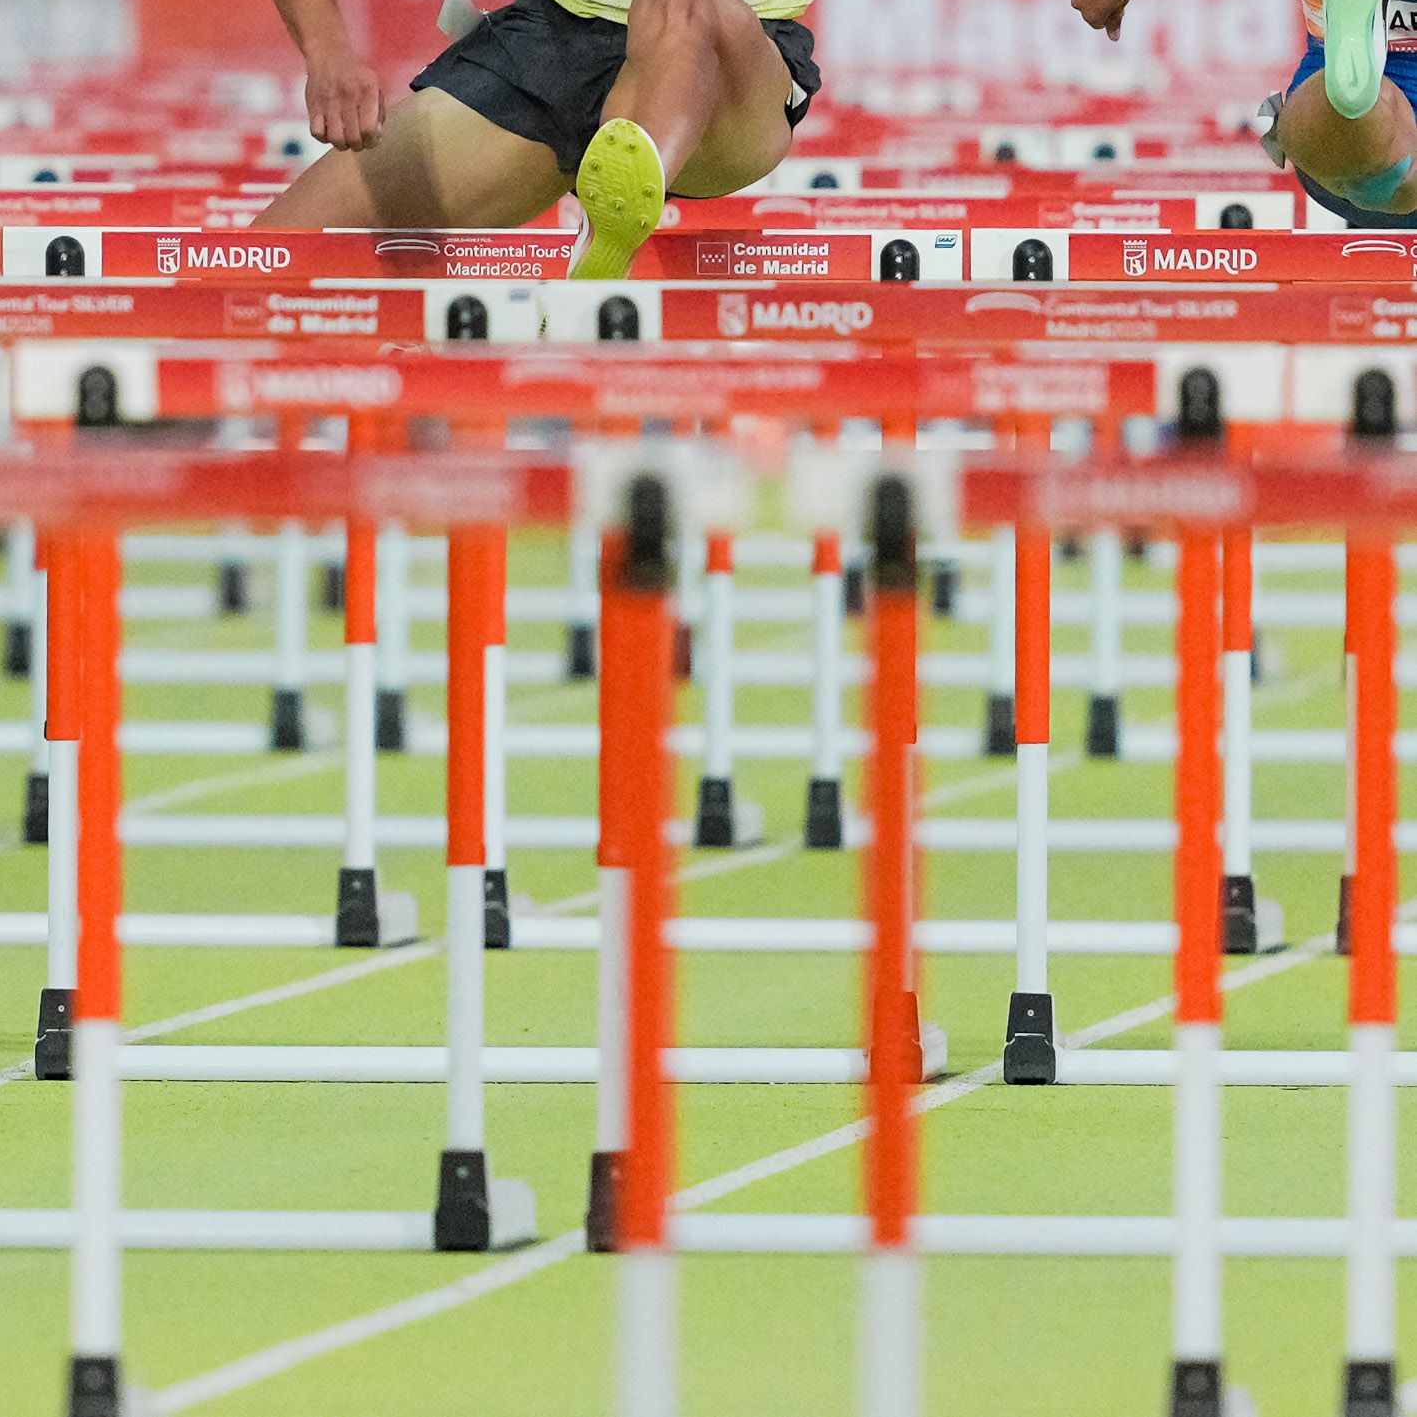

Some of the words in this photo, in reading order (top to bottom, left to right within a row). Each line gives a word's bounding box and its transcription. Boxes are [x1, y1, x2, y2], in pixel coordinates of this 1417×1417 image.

[443, 243, 526, 258] Continental
[528, 244, 560, 258] Tour
[733, 242, 829, 258] Comunidad
[188, 247, 290, 272] MADRID
[733, 259, 760, 275] de
[763, 261, 828, 274] Madrid
[1155, 249, 1257, 274] MADRID
[446, 262, 543, 276] Madrid2026
[753, 302, 873, 335] MADRID
